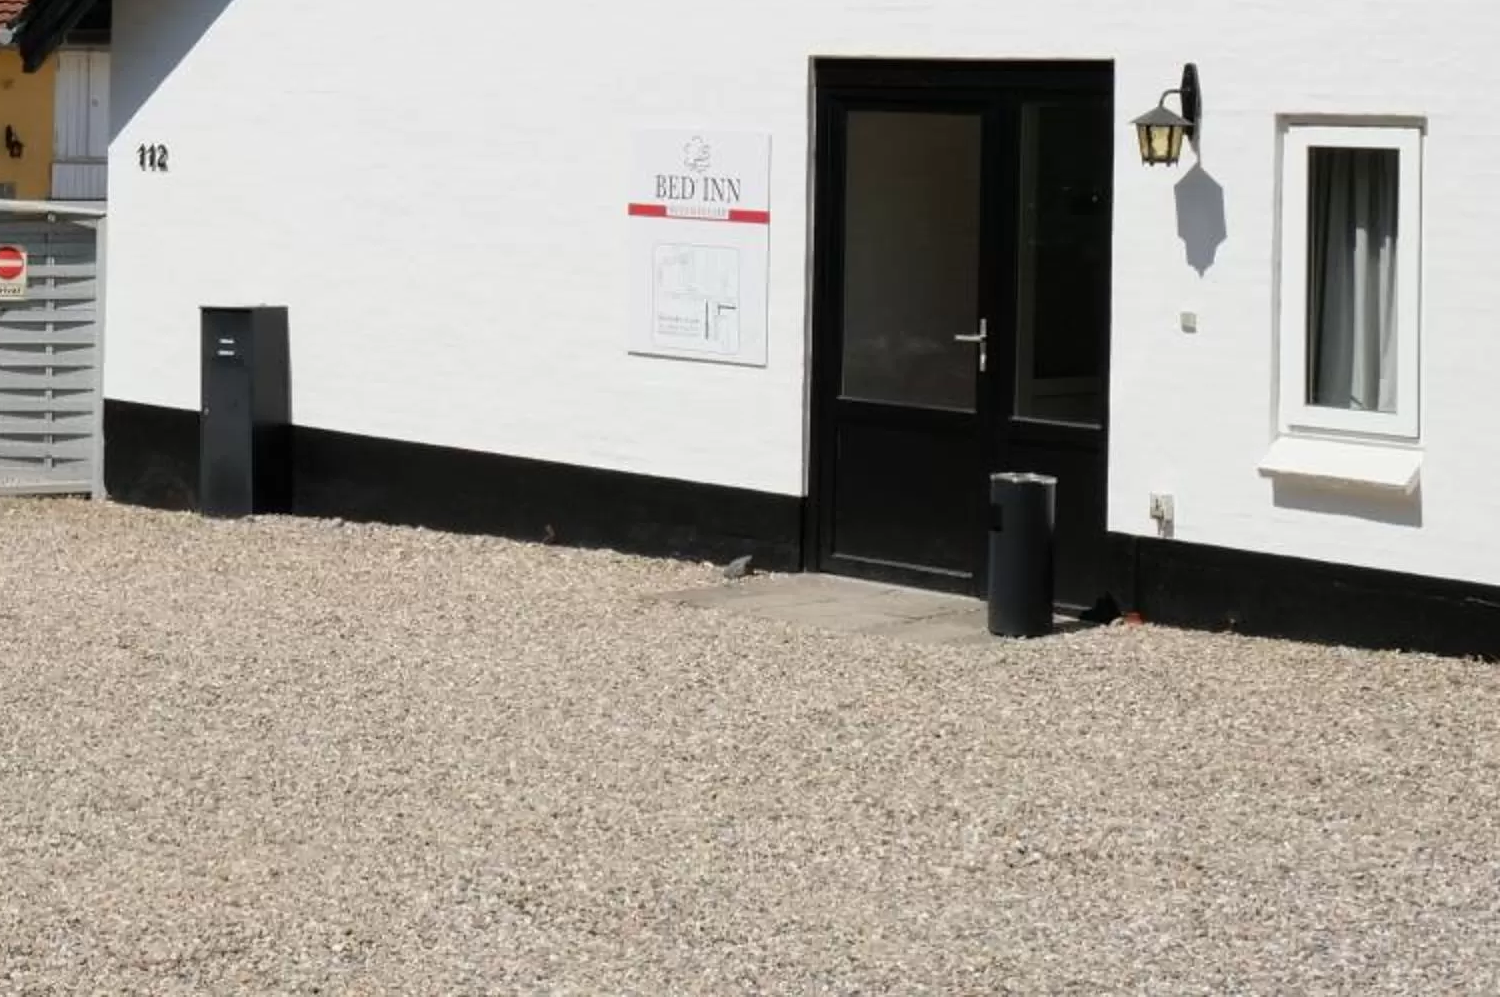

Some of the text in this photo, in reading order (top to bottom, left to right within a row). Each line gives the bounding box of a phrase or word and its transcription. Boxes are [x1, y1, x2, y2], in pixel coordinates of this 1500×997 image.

[136, 143, 169, 171] 112
[656, 174, 741, 203] BED INN
